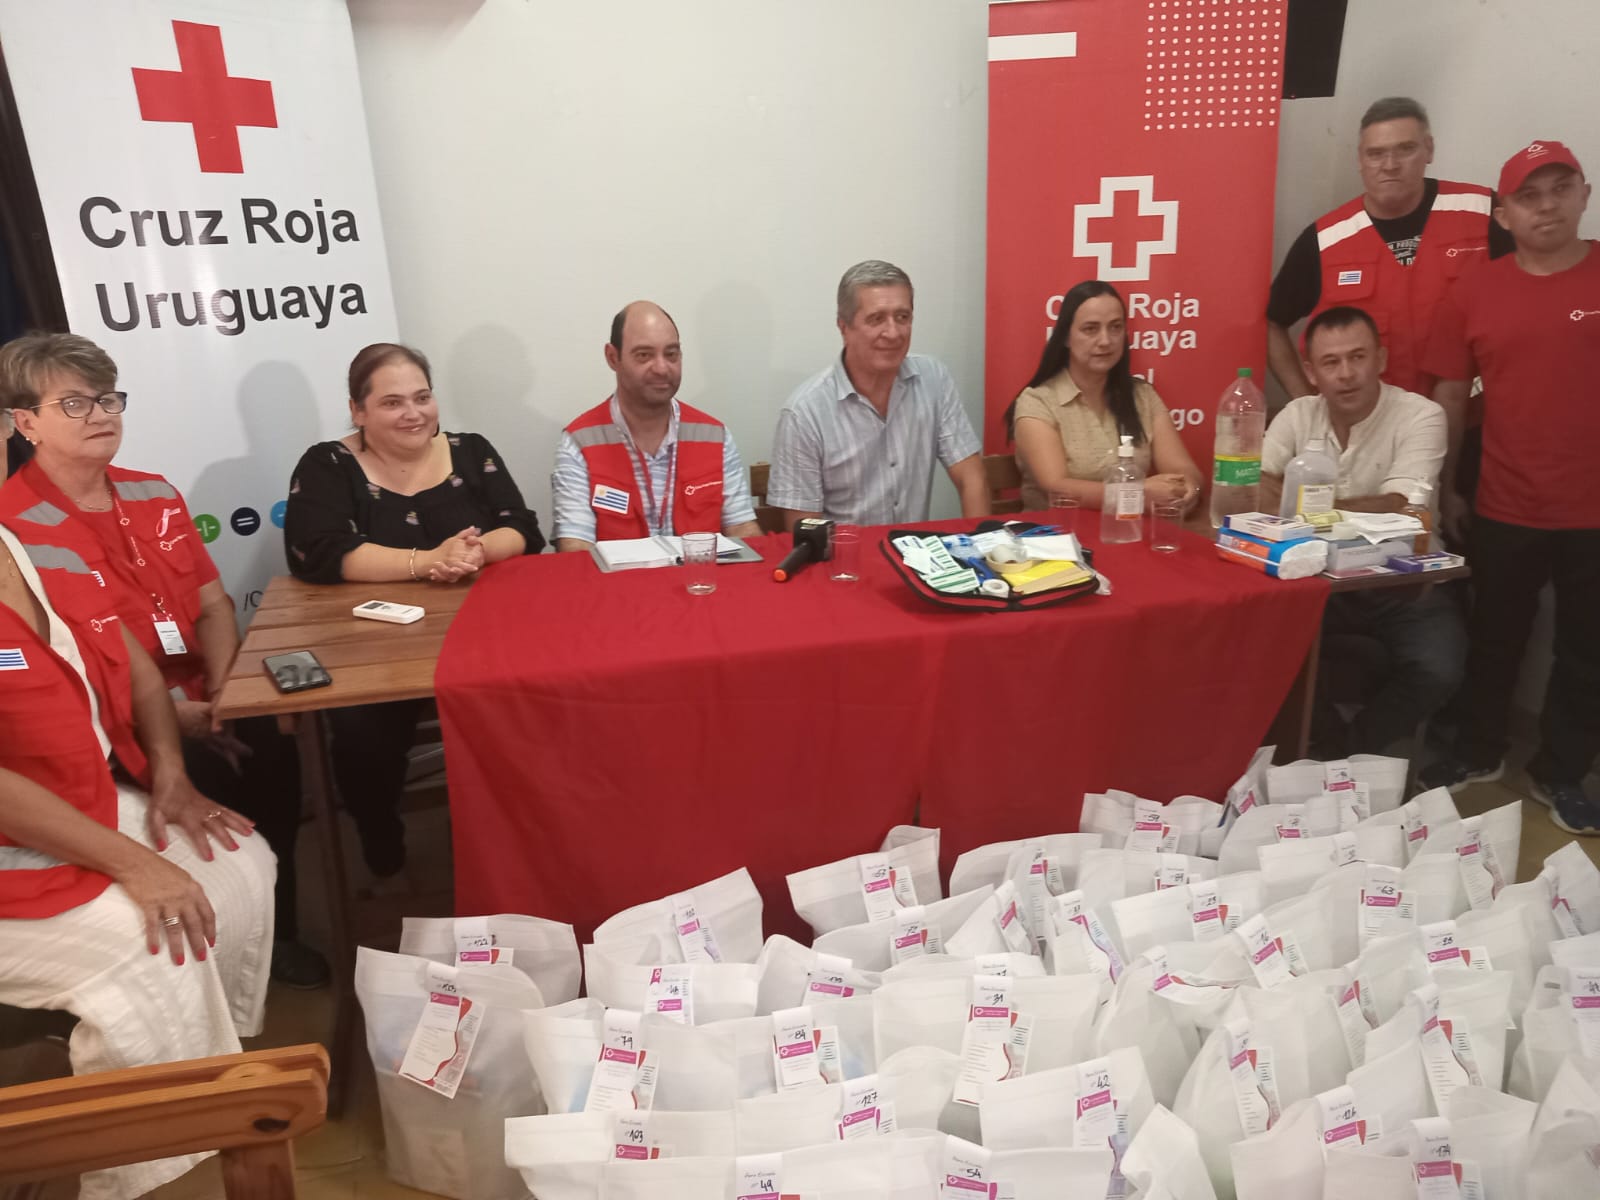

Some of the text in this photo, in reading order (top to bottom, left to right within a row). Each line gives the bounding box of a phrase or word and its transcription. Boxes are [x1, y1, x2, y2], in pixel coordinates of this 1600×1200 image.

[79, 196, 360, 255] Cruz Roja
[95, 282, 368, 336] Uruguaya
[1128, 292, 1200, 325] Roja
[794, 1029, 806, 1041] 84
[620, 1036, 633, 1050] 79
[1096, 1075, 1110, 1089] 42
[861, 1092, 878, 1107] 127
[628, 1130, 642, 1143] 103
[965, 1168, 981, 1179] 54
[759, 1180, 774, 1192] 49
